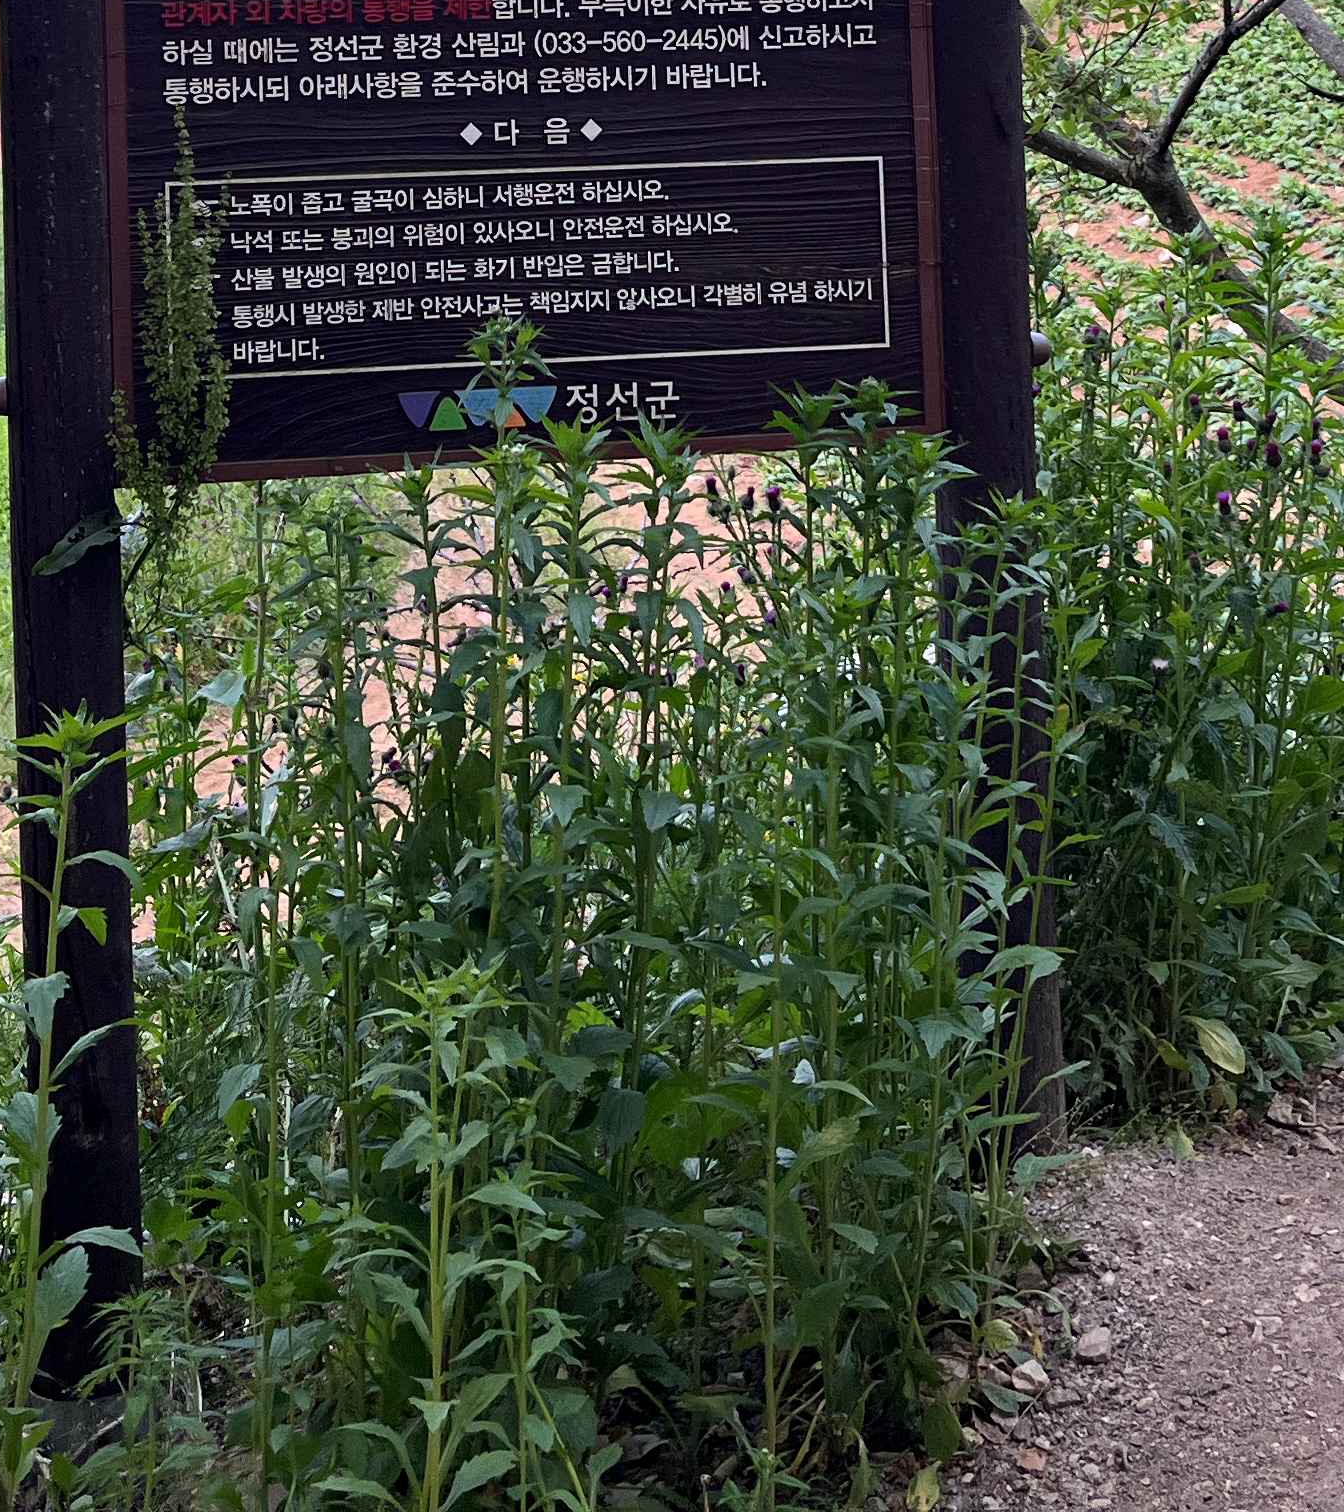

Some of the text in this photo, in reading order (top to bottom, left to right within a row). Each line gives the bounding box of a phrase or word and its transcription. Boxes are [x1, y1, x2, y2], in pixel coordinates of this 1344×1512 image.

[161, 0, 237, 27] 관계자
[245, 0, 272, 25] 외
[162, 23, 877, 66] 하실 때에는 정선군 환경 산림과 (033-560-2445)에 신고하시고
[163, 62, 767, 105] 통행하시되 아래사항을 준수하여 운행하시기 바랍니다.
[230, 179, 669, 217] 노폭이 좁고 굴곡이 심하니 서행운전 하십시오.
[230, 212, 739, 254] 낙석 또는 붕괴의 위험이 있사오니 안전운전 하십시오.
[231, 250, 679, 292] 산불 발생의 원인이 되는 화기 반입은 금합니다.
[231, 278, 872, 329] 통행시 발생한 제반 안전사고는 책임지지 않사오니 각별히 유념 하시기
[233, 337, 325, 365] 바랍니다.
